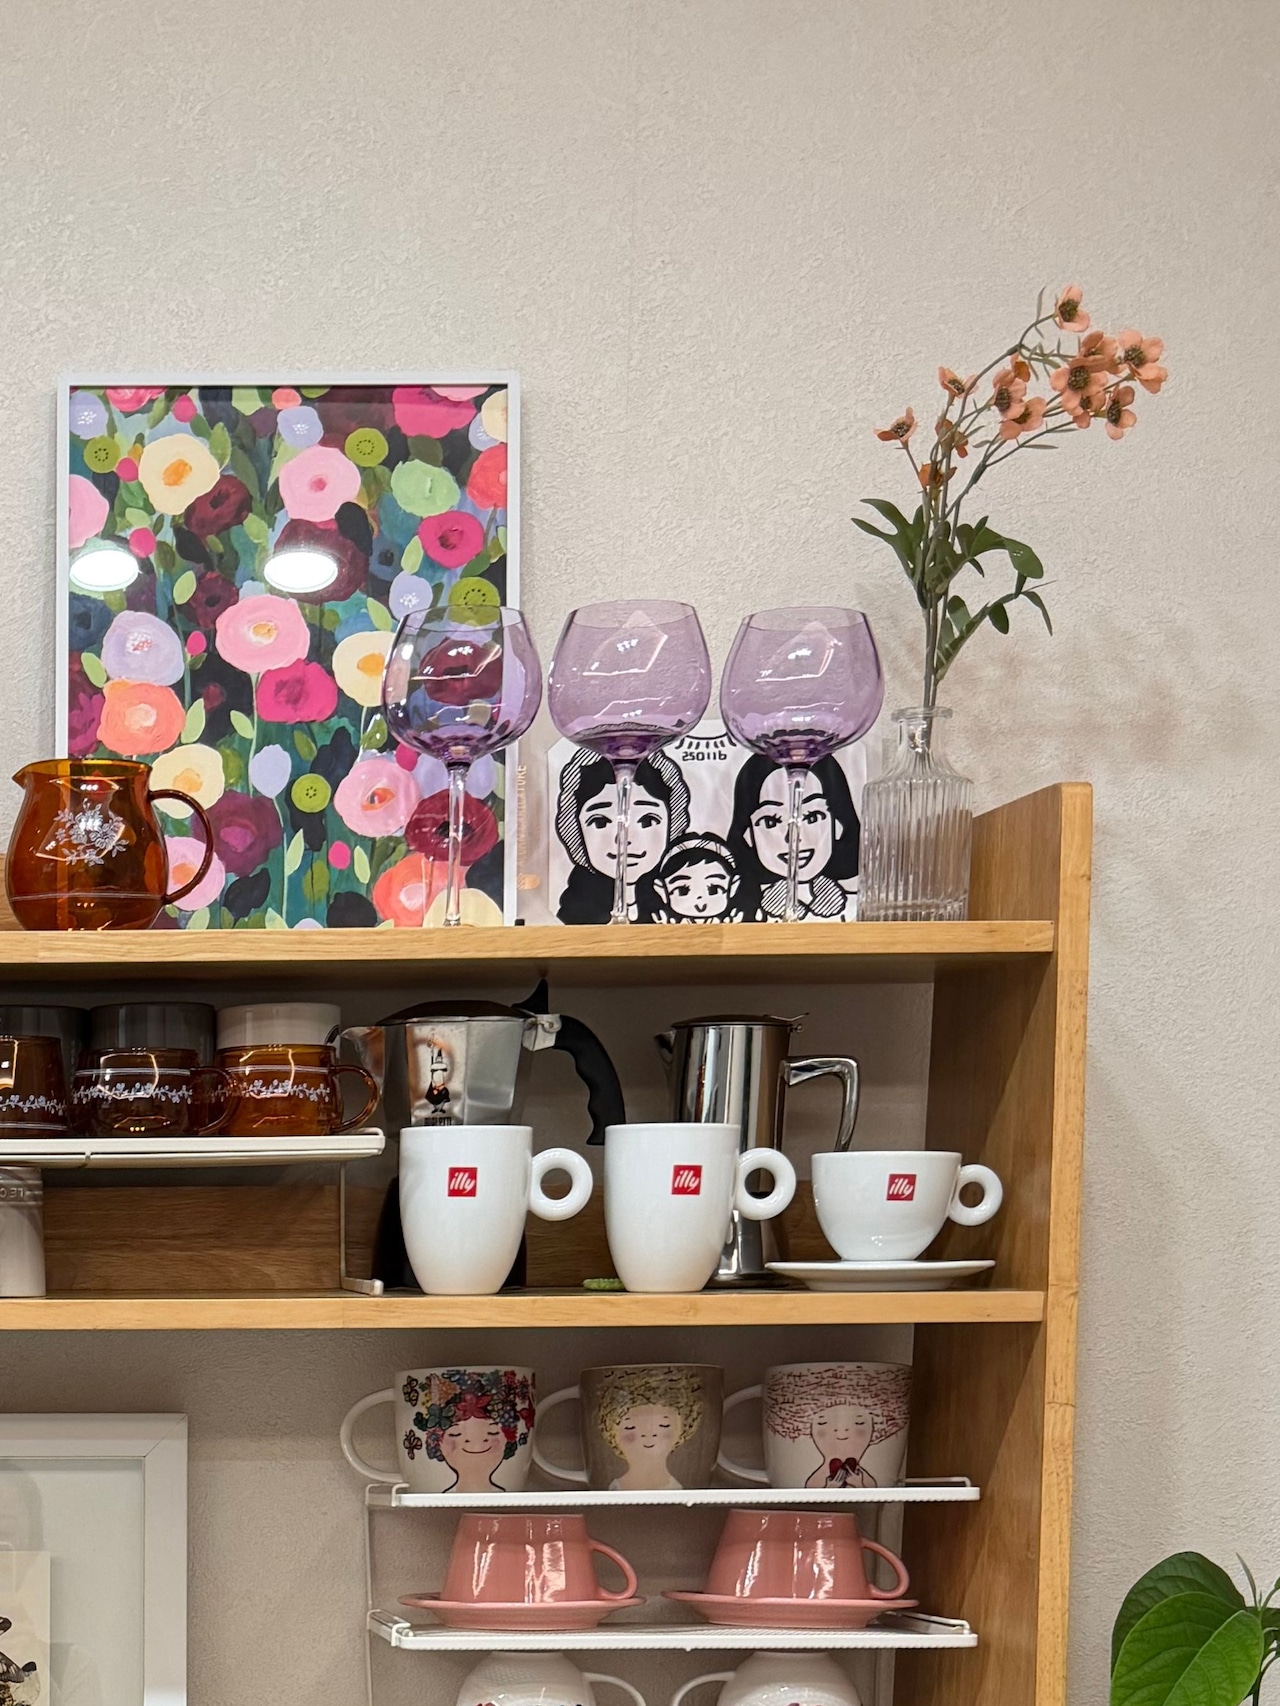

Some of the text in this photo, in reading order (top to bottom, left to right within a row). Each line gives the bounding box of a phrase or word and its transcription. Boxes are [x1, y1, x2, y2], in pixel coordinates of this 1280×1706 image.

[450, 1171, 476, 1194] illy
[674, 1169, 700, 1192] illy
[888, 1177, 914, 1199] illy
